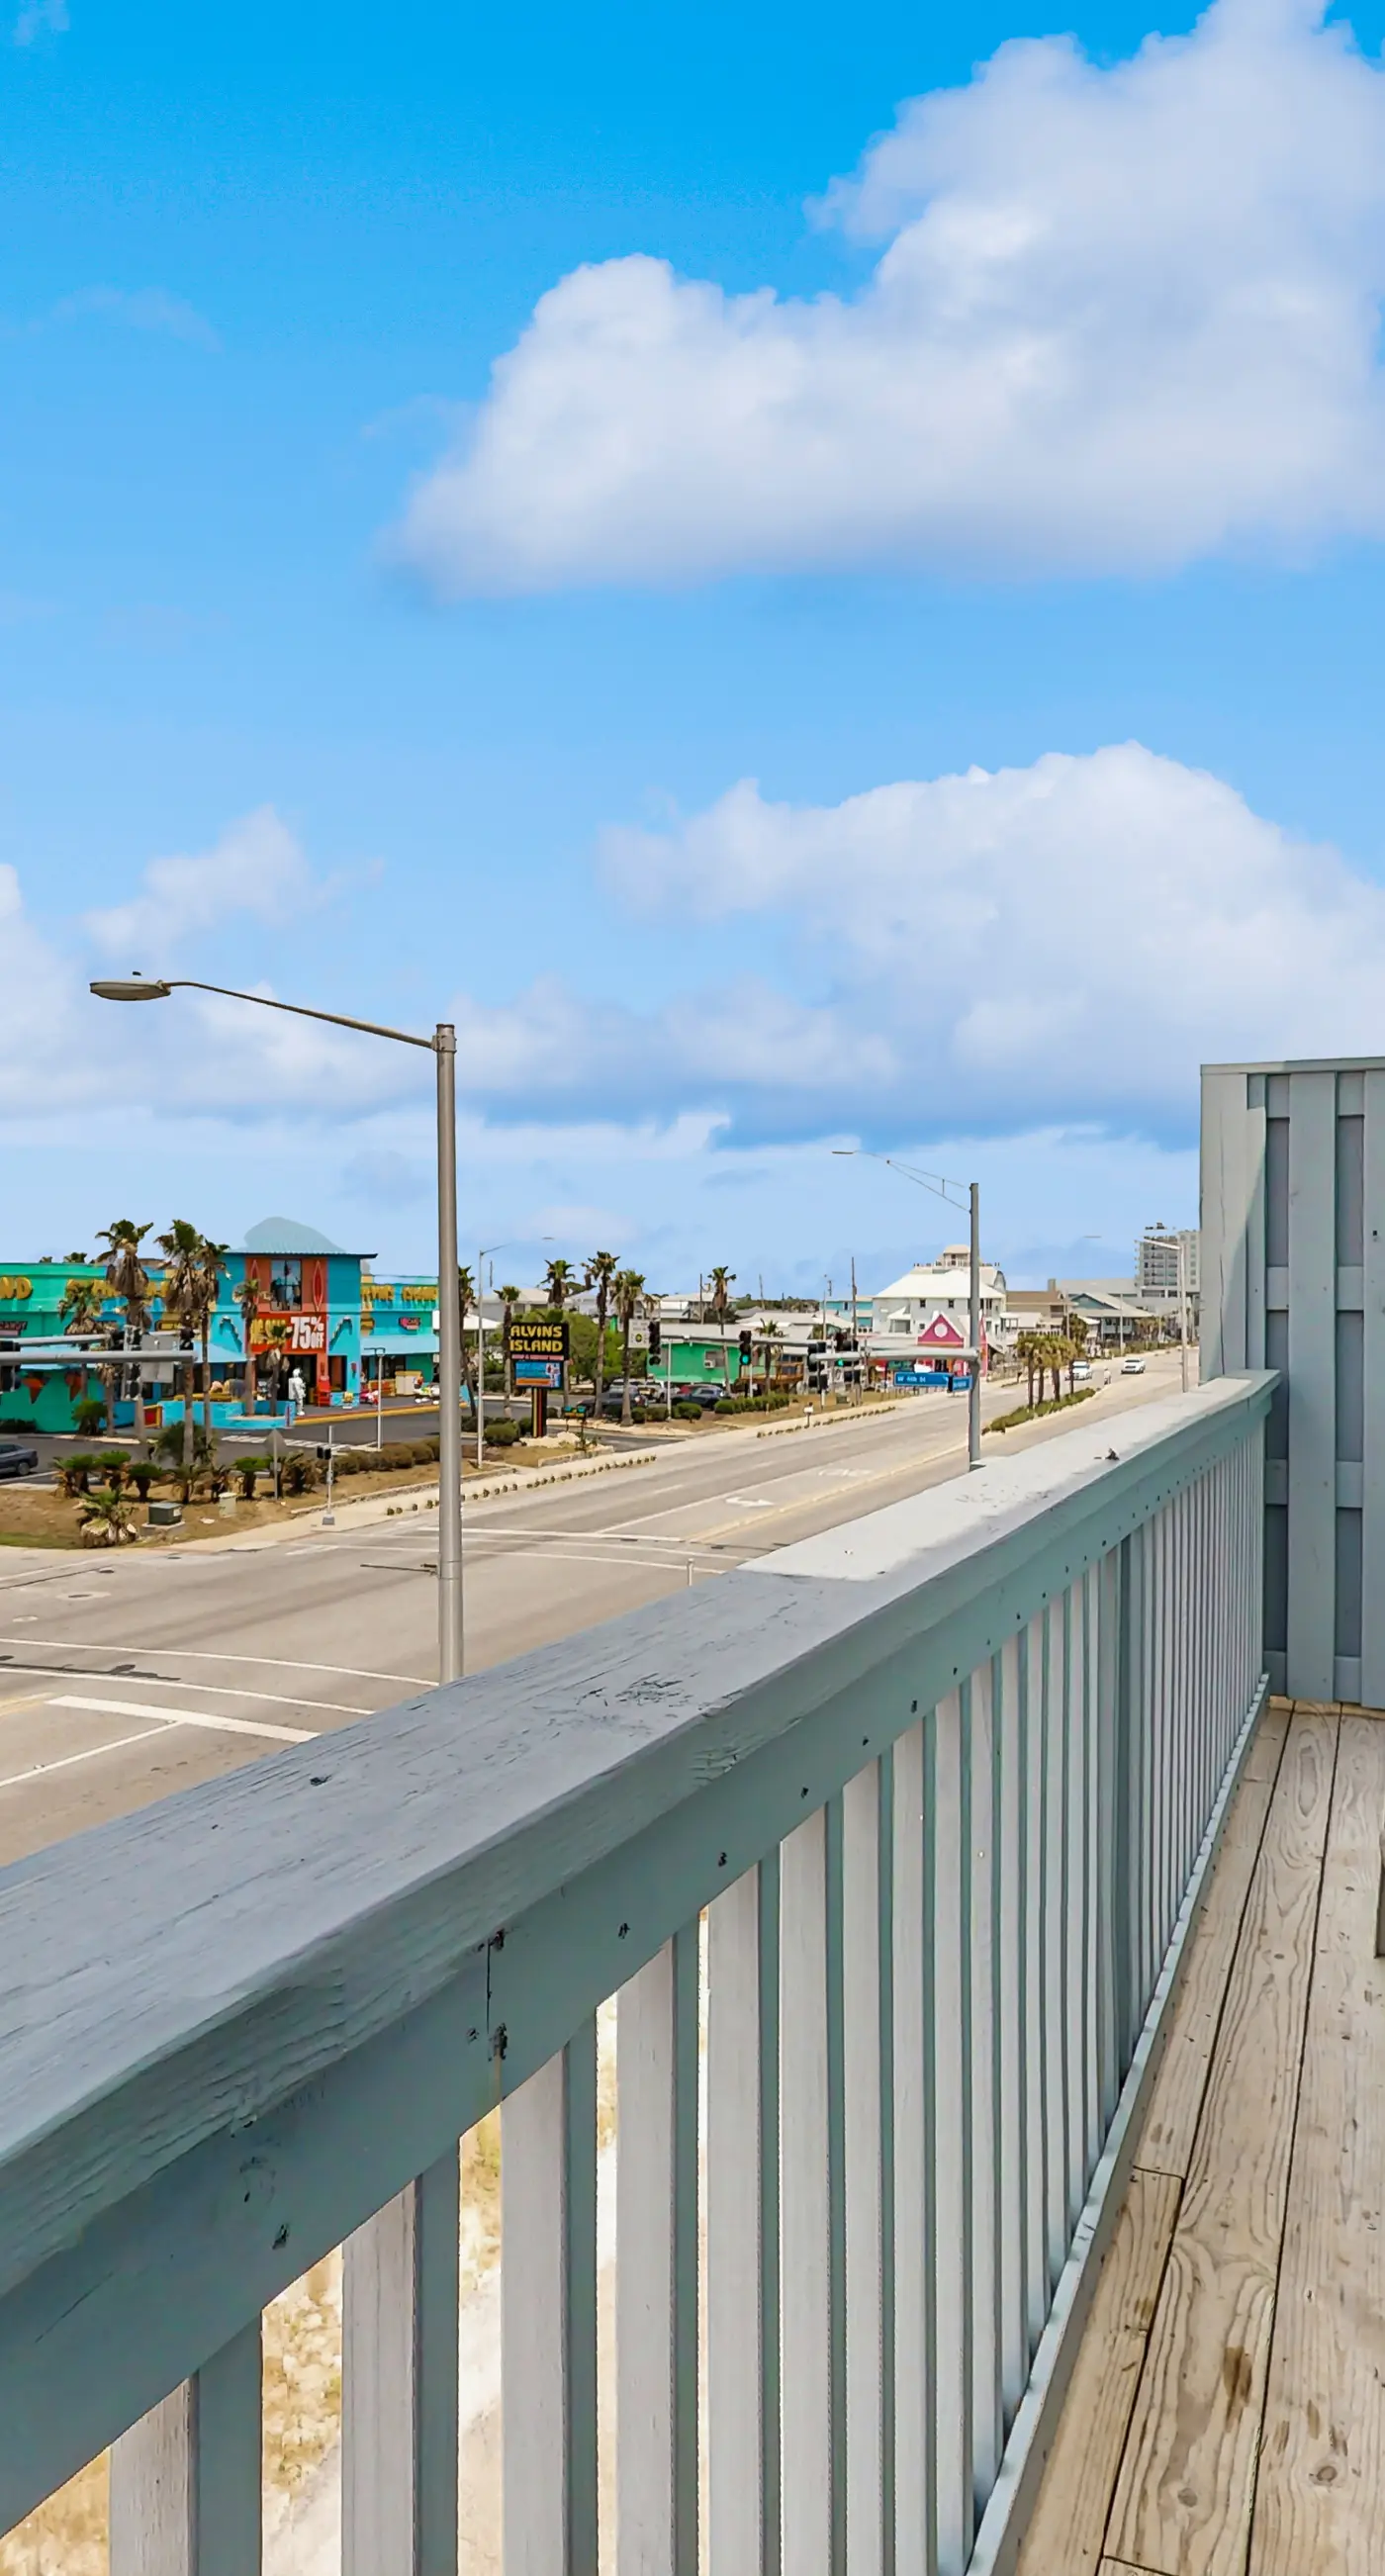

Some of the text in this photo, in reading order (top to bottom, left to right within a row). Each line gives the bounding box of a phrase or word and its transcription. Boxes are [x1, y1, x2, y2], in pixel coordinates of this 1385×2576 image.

[291, 1317, 324, 1349] 75%
[311, 1333, 324, 1348] OFF
[509, 1340, 563, 1352] ISLAND
